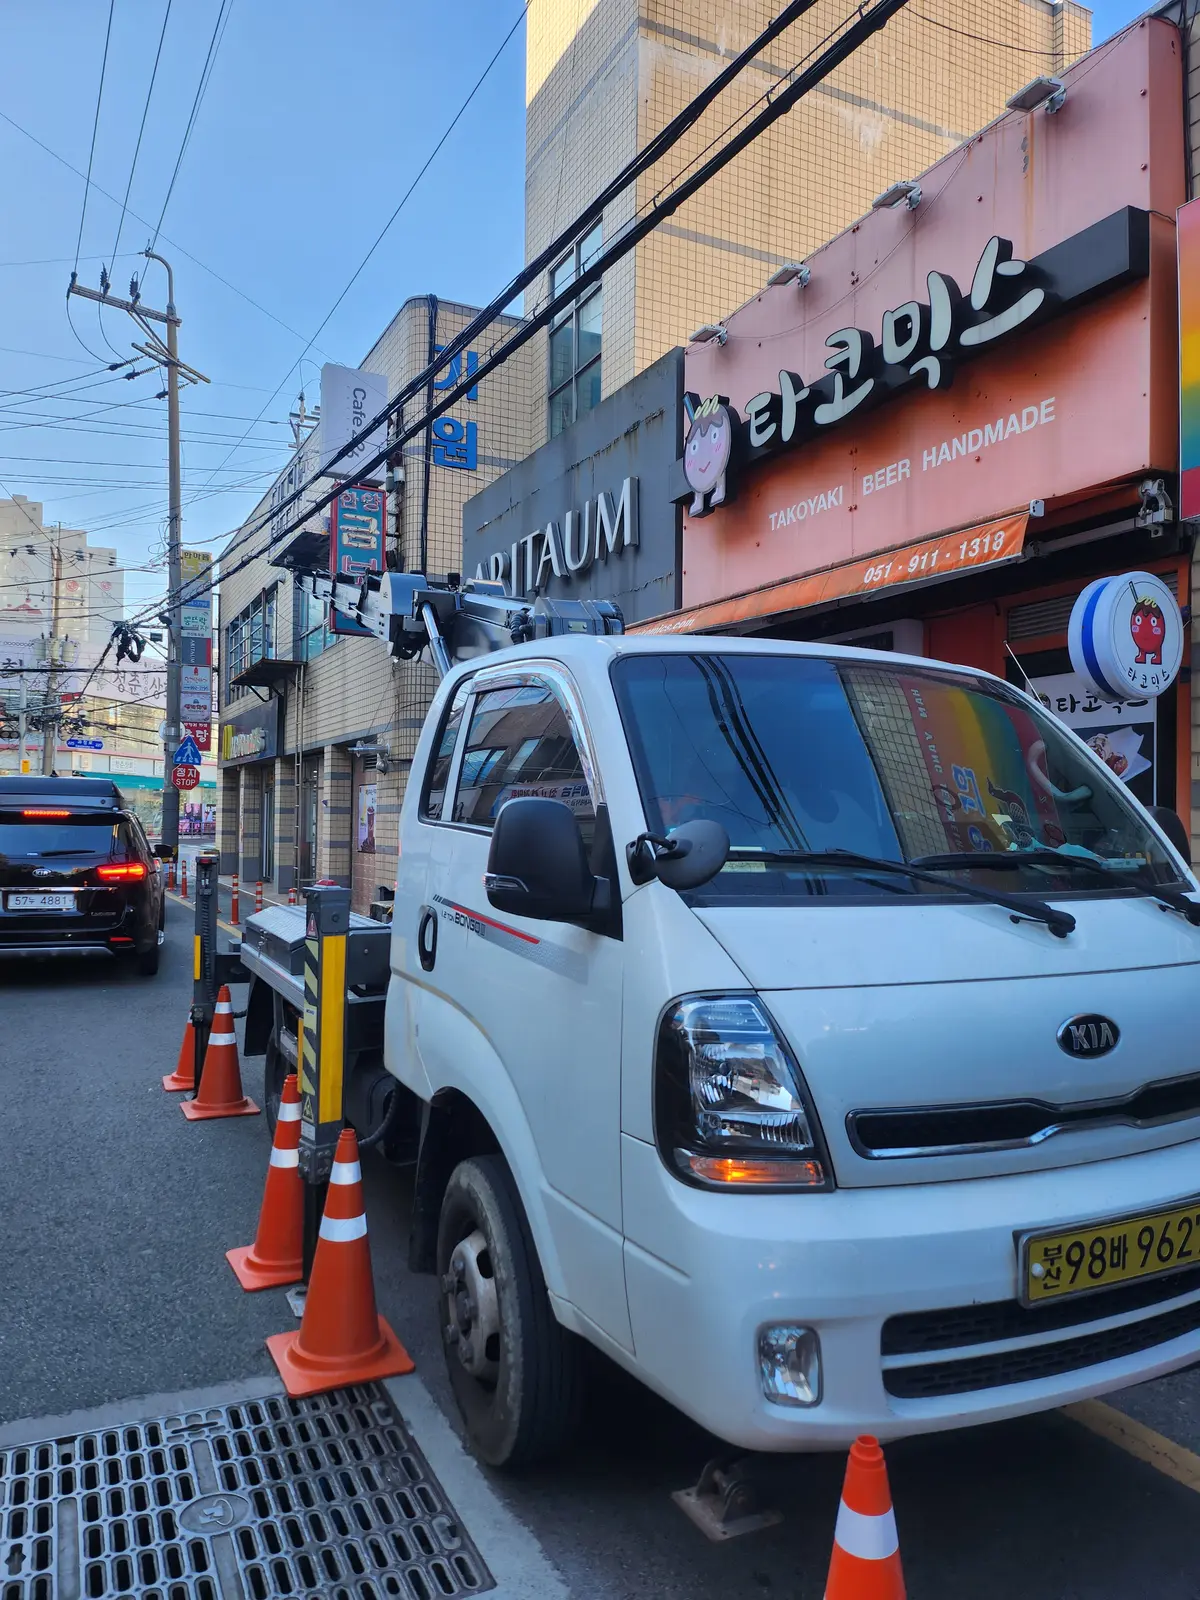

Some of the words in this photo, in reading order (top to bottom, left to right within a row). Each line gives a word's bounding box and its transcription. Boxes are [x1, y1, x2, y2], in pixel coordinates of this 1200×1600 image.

[744, 236, 1047, 449] 타코믹스
[352, 387, 367, 427] Cafe
[432, 344, 479, 471] 기원
[768, 485, 844, 532] TAKOYAKI
[862, 458, 912, 496] BEER
[922, 396, 1057, 471] HANDMADE
[863, 562, 893, 584] 051
[907, 549, 939, 573] 911
[149, 677, 167, 700] 상
[1127, 667, 1170, 690] 타코믹스
[175, 778, 196, 786] STOP
[176, 767, 197, 778] 정지
[35, 869, 49, 877] KIA
[40, 896, 66, 905] 4881
[455, 912, 480, 934] BONGO
[1068, 1022, 1115, 1050] KIA
[1065, 1233, 1129, 1285] 98바
[1137, 1214, 1200, 1268] 962
